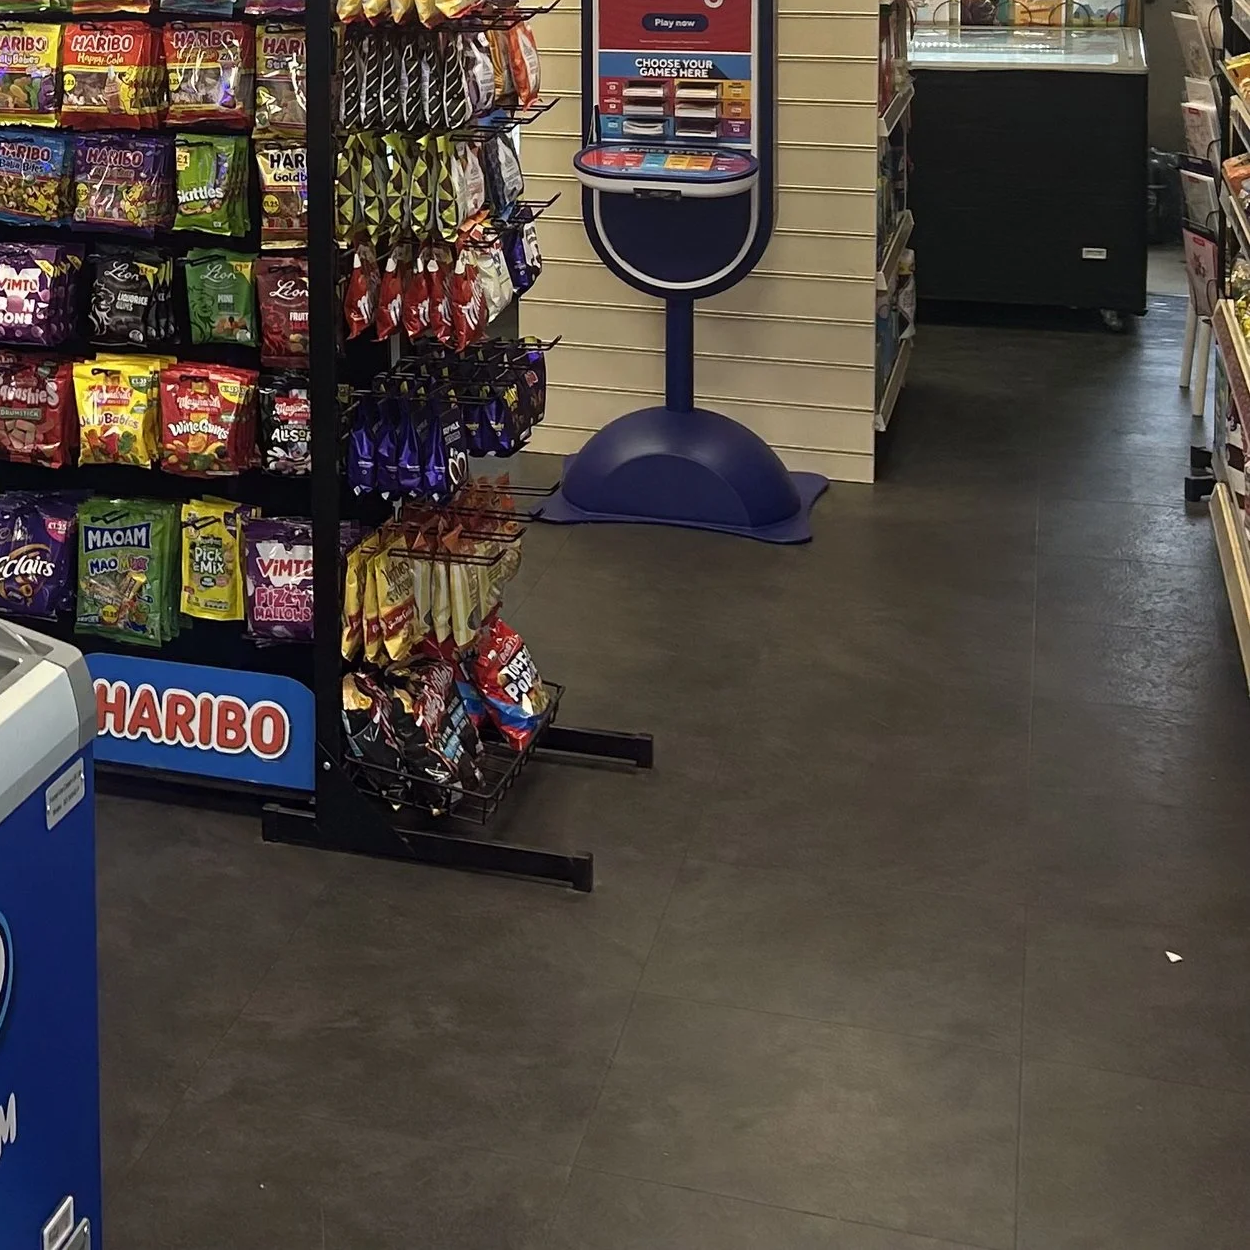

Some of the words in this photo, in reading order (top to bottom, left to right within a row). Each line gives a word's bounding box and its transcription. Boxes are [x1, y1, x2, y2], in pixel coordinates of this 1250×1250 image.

[654, 18, 674, 29] Play
[675, 19, 696, 27] now
[71, 34, 133, 53] HARIBO
[173, 30, 236, 48] HARIBO
[77, 54, 104, 65] Happy
[106, 54, 124, 64] Cola
[635, 58, 681, 69] CHOOSE
[682, 59, 713, 69] YOUR
[639, 67, 677, 77] GAMES
[679, 68, 709, 78] HERE
[86, 147, 143, 167] HARIBO
[270, 152, 307, 168] HAR
[177, 184, 224, 204] Skittles
[104, 260, 139, 281] Lion
[200, 263, 237, 281] Lion
[269, 279, 309, 298] Lion
[117, 292, 148, 306] LIQUORICE
[168, 421, 199, 437] Wine
[200, 419, 230, 440] Gums
[88, 529, 147, 549] MAOAM
[194, 547, 223, 562] Pick
[200, 559, 224, 574] Mix
[256, 587, 308, 607] FIZZY
[255, 607, 312, 623] MALLOWS
[93, 678, 289, 759] HARIBO
